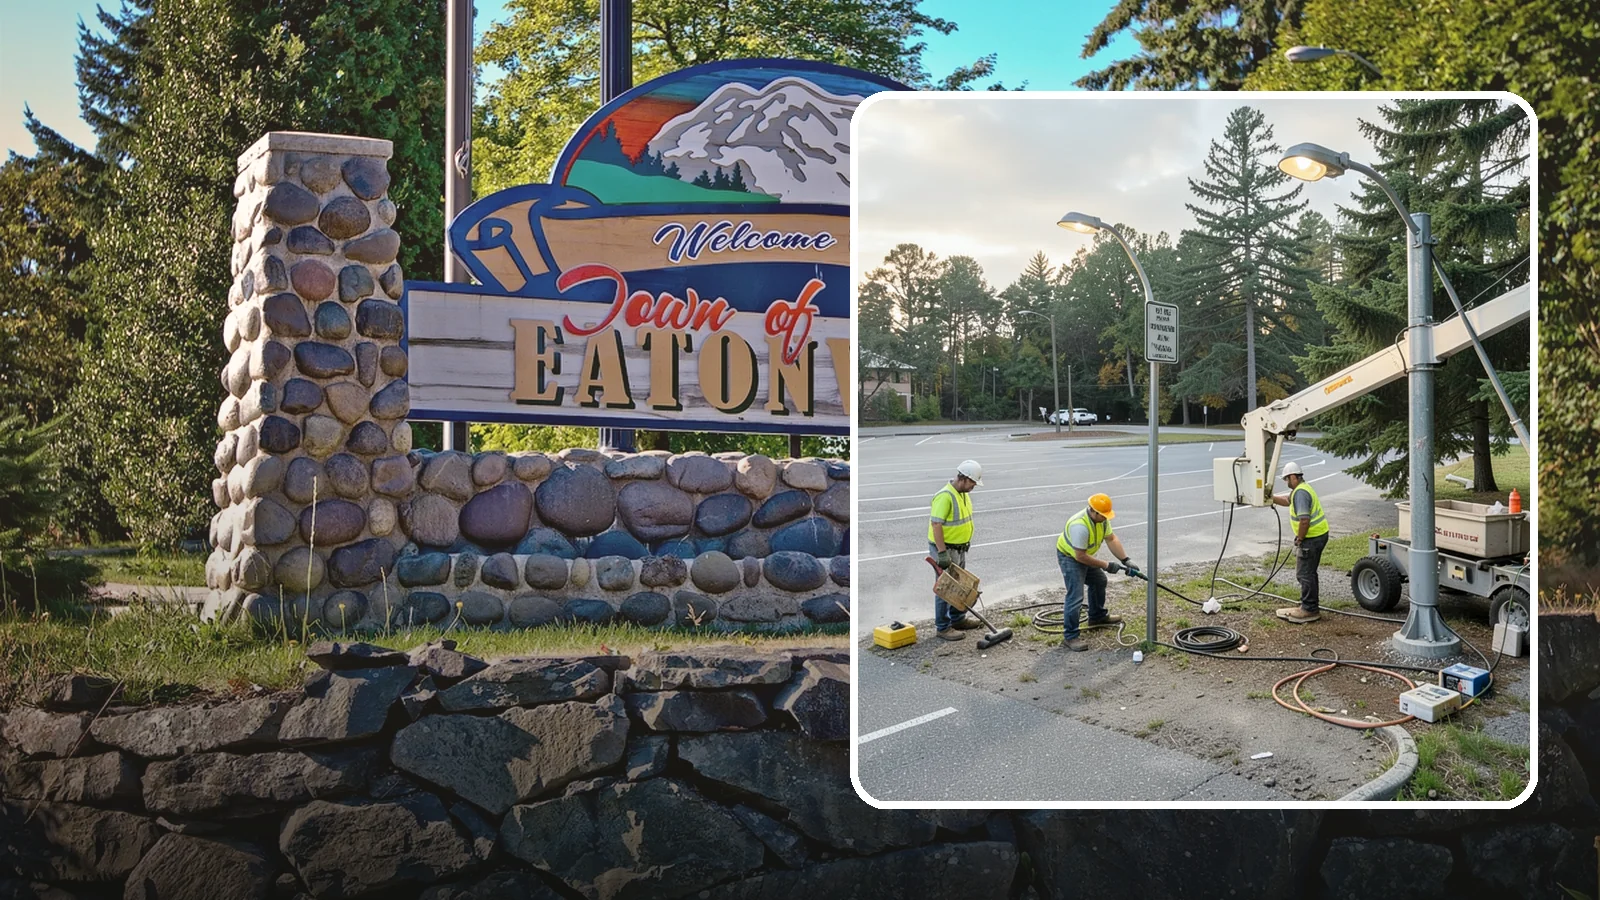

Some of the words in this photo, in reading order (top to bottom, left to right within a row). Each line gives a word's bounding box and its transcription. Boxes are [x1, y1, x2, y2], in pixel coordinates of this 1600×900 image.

[653, 220, 836, 263] Welcome
[556, 263, 736, 335] Town
[765, 279, 826, 365] of
